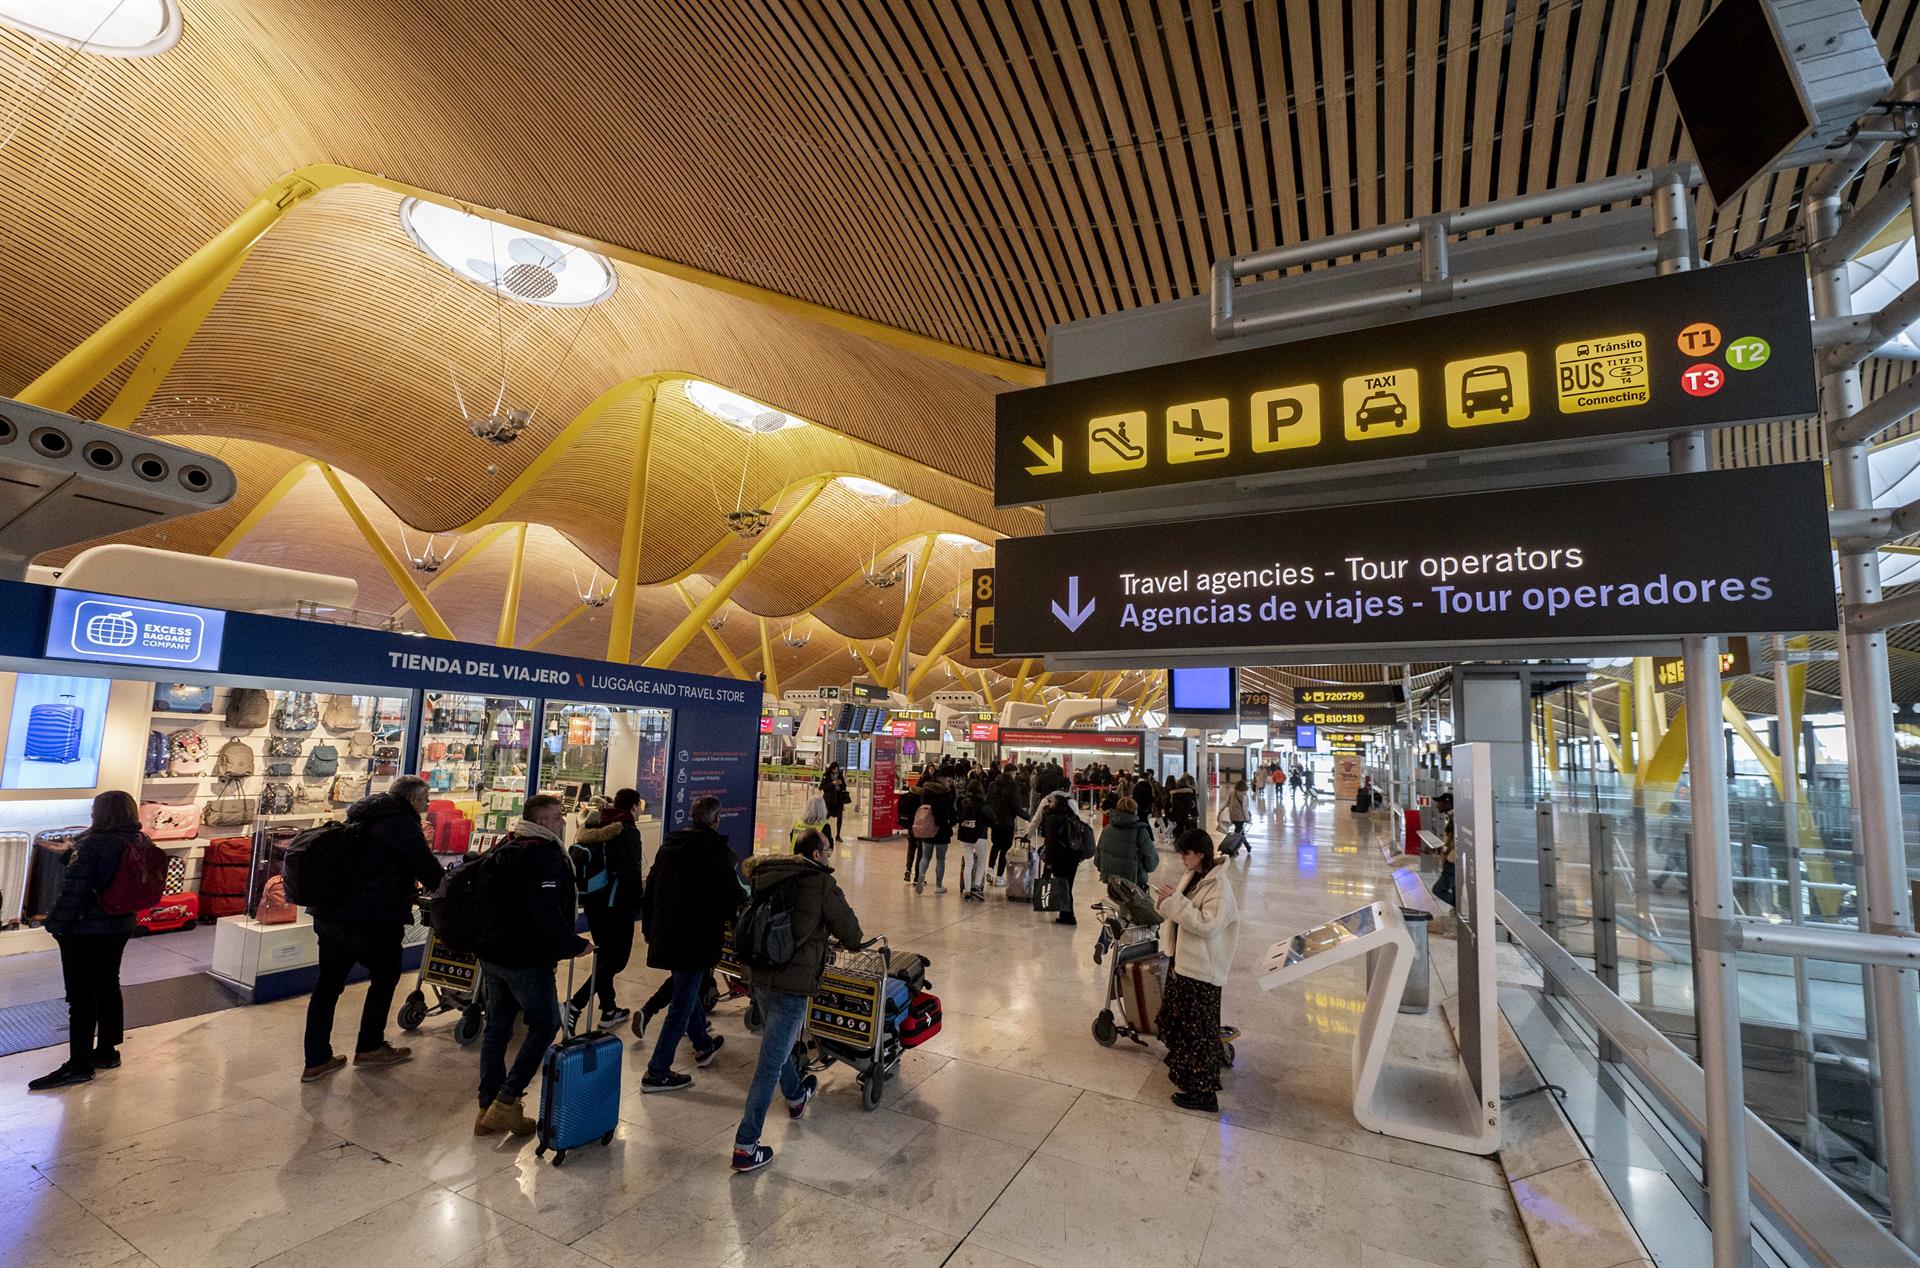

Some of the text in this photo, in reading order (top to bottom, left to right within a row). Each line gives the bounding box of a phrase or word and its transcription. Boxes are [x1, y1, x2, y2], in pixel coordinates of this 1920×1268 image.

[1594, 338, 1642, 353] Tránsito
[1682, 329, 1715, 350] T1
[1619, 357, 1630, 365] T2
[1730, 343, 1765, 363] T2
[1365, 375, 1397, 390] TAXI
[1561, 362, 1604, 392] BUS
[1685, 370, 1720, 390] T3
[1578, 390, 1646, 406] Connecting
[1268, 398, 1304, 442] P
[1120, 571, 1189, 595] Travel
[1196, 564, 1315, 595] agencies
[1345, 557, 1408, 581] Tour
[1421, 546, 1584, 581] operators
[1120, 599, 1252, 632] Agencias
[1259, 595, 1296, 622] de
[1304, 591, 1404, 624] viajes
[1431, 585, 1511, 614] Tour
[1522, 574, 1773, 616] operadores
[143, 632, 191, 643] BAGGAGE
[144, 623, 192, 636] EXCESS
[142, 639, 191, 650] COMPANY
[388, 651, 745, 703] TIENDA DEL VIAJERO LUGGAGE AND TRAVEL STORE
